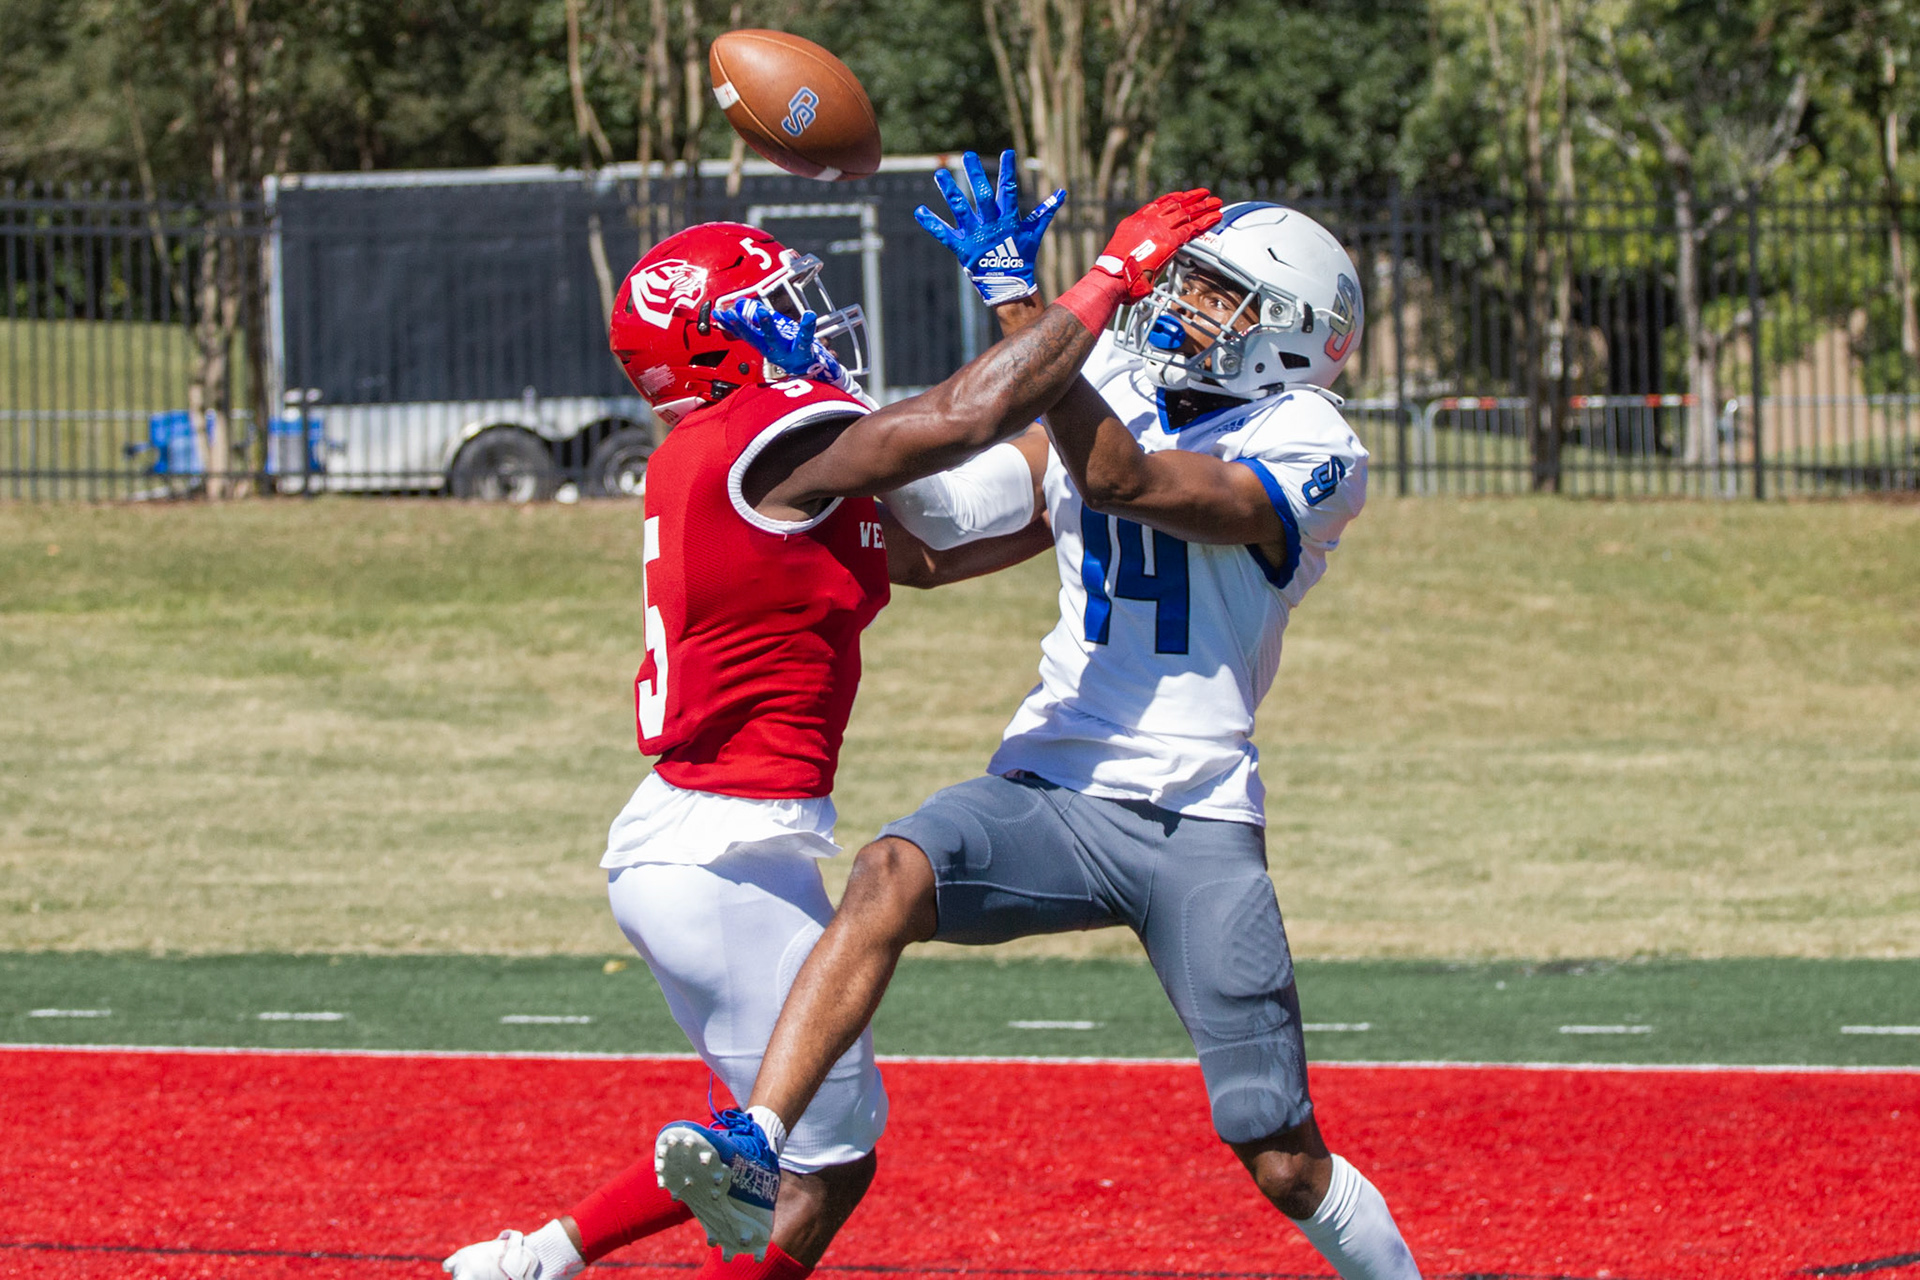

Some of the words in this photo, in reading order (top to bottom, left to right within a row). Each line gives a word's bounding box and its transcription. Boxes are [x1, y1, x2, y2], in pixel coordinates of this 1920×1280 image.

[739, 237, 772, 271] 5
[978, 255, 1024, 268] adidas
[859, 521, 886, 549] WE
[1081, 501, 1190, 655] 14
[638, 515, 669, 741] 5
